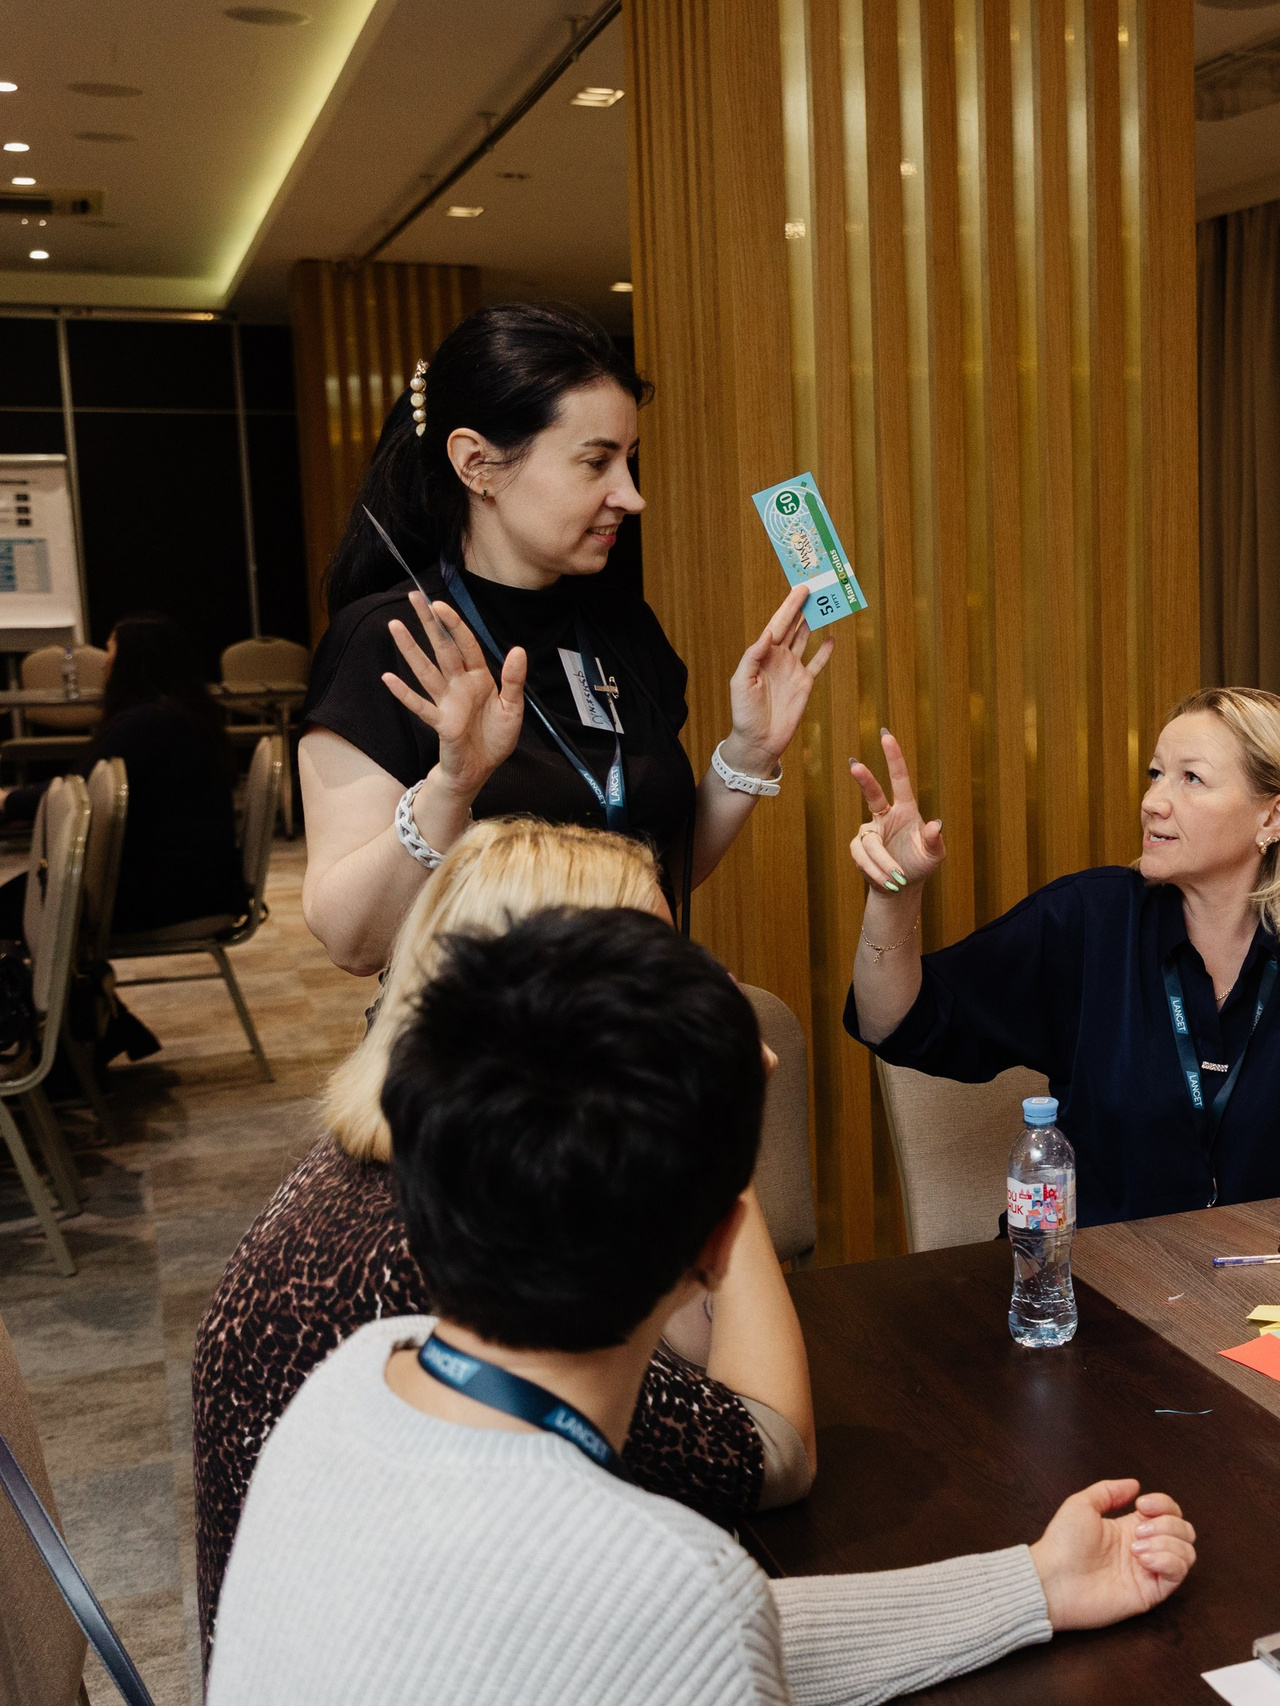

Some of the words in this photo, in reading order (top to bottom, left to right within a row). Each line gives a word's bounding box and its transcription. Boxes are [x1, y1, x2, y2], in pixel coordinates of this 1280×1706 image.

[780, 492, 797, 514] 50
[830, 549, 857, 604] ManGOcoins
[816, 595, 834, 616] 50
[583, 773, 607, 805] LANCET
[611, 769, 620, 802] LANCET
[1172, 999, 1187, 1032] LANCET
[1189, 1074, 1203, 1107] LANCET
